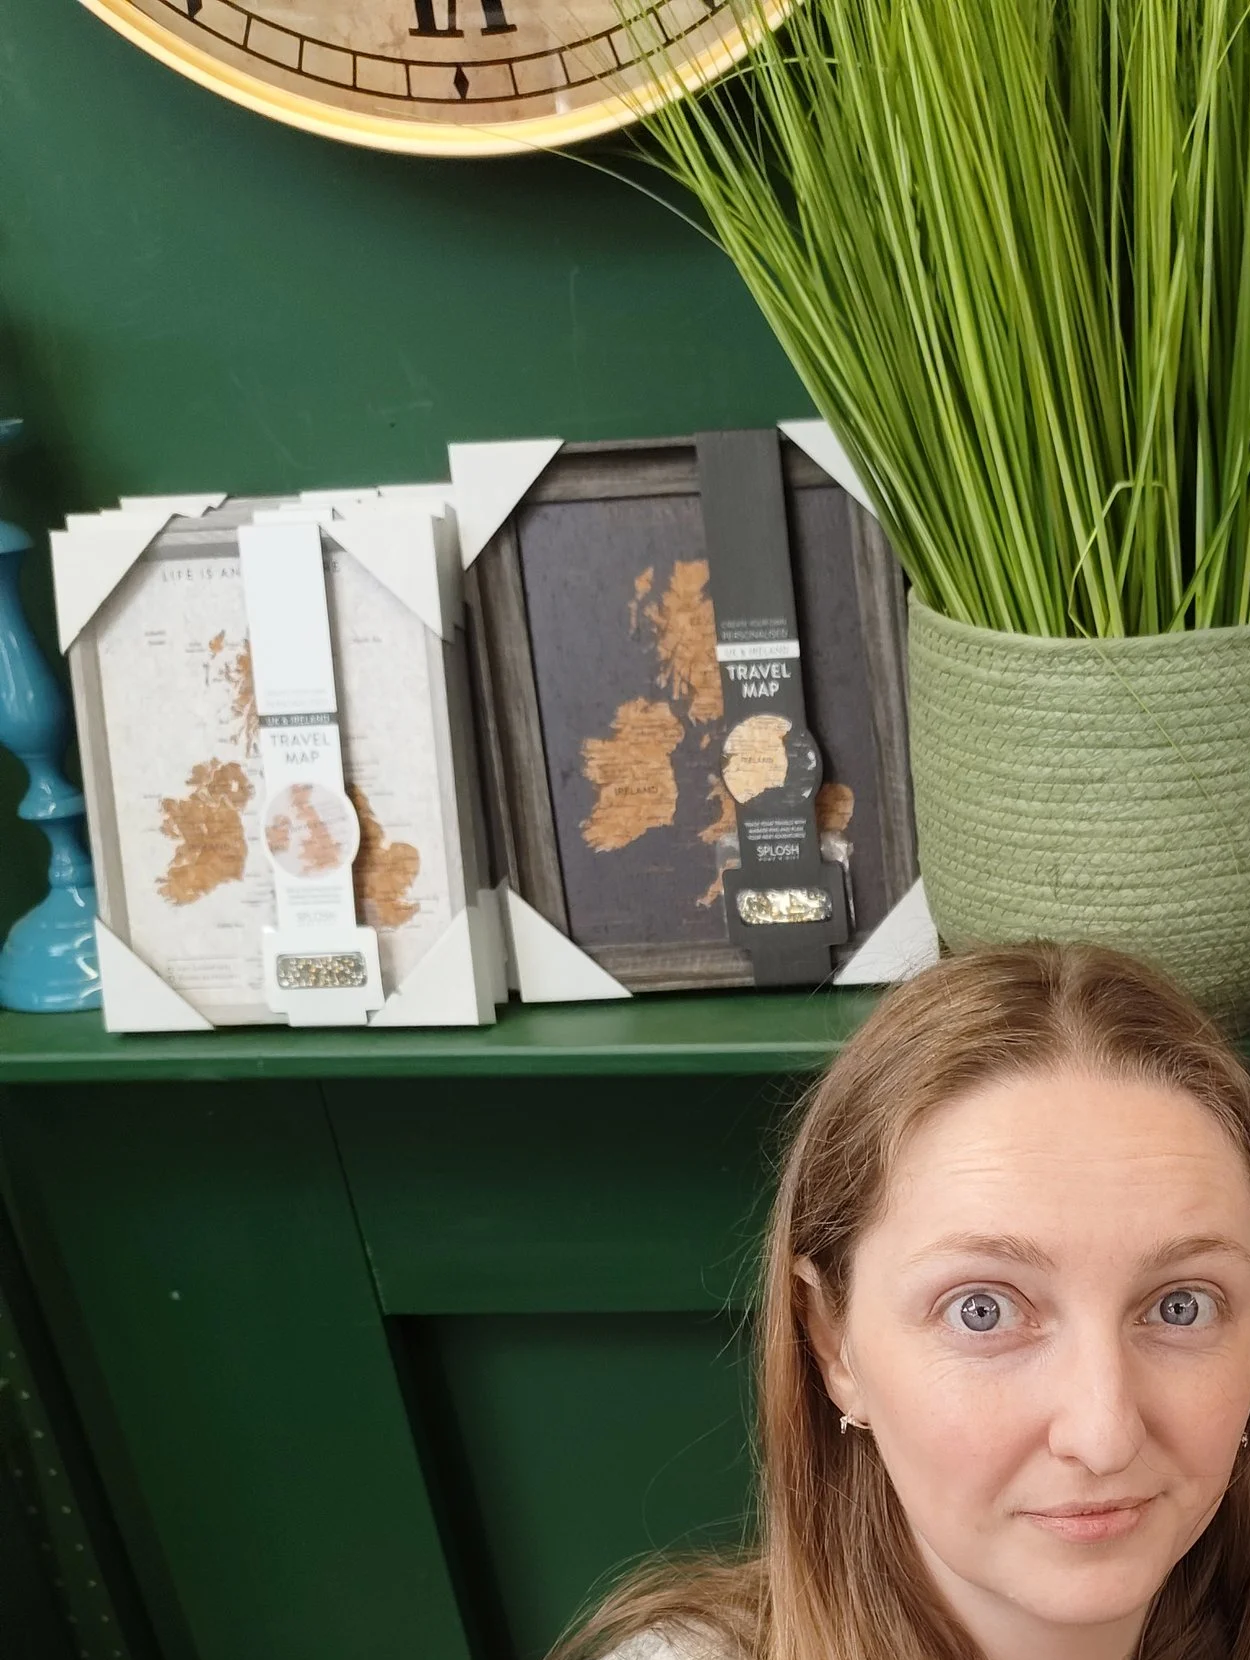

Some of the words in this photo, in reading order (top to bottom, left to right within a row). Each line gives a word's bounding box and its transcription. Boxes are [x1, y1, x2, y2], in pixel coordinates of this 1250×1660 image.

[162, 569, 194, 582] LIFE
[201, 568, 213, 580] IS
[725, 662, 792, 681] TRAVEL
[742, 680, 780, 699] MAP
[270, 732, 331, 748] TRAVEL
[286, 750, 320, 765] MAP
[614, 785, 659, 796] IRELAND
[756, 843, 800, 857] SPLOSH
